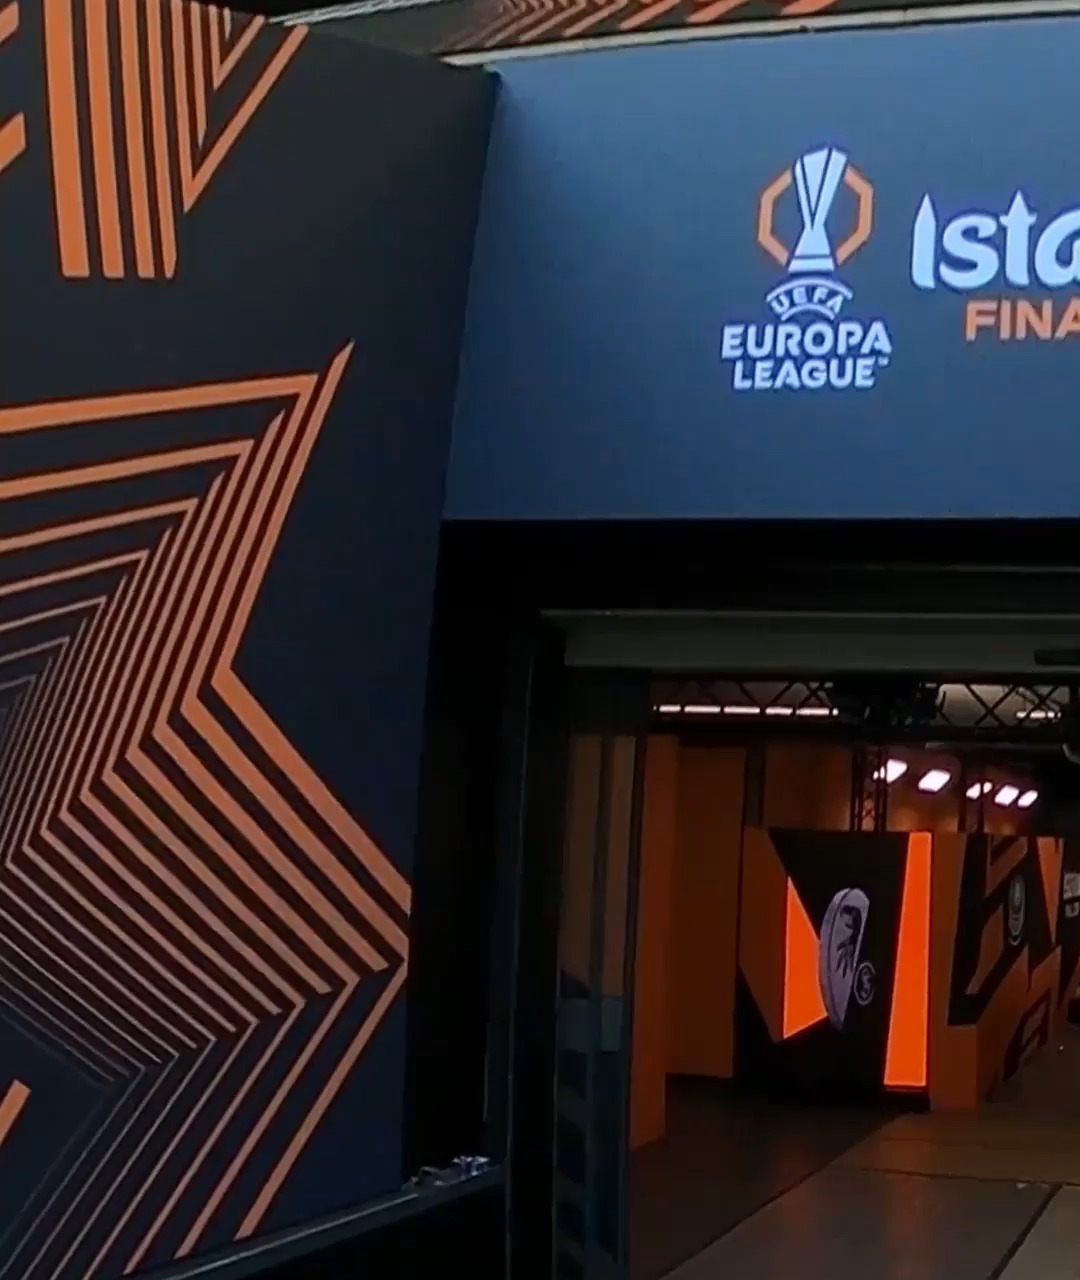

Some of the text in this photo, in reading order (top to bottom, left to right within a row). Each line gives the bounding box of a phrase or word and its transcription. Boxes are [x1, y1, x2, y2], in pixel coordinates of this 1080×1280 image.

[770, 286, 844, 314] UEFA
[721, 320, 892, 359] EUROPA
[733, 356, 876, 390] LEAGUE
